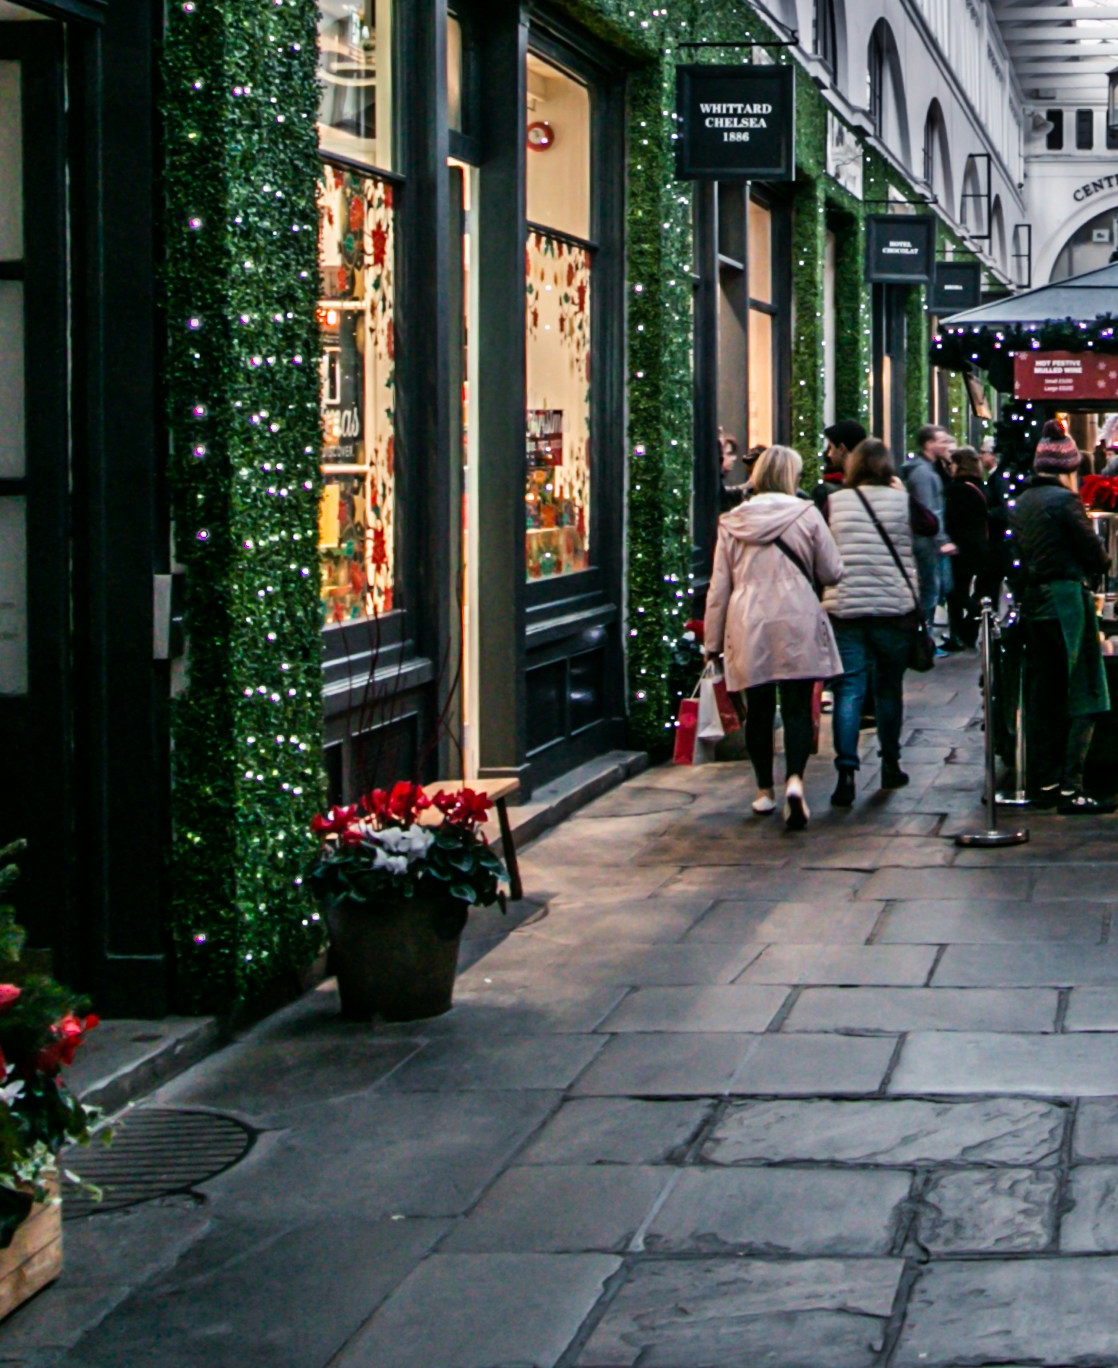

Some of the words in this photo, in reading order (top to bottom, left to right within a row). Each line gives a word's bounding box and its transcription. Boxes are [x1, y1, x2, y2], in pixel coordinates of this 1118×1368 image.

[700, 103, 773, 114] WHITTARD
[704, 117, 767, 128] CHELSEA
[723, 131, 750, 142] 1886
